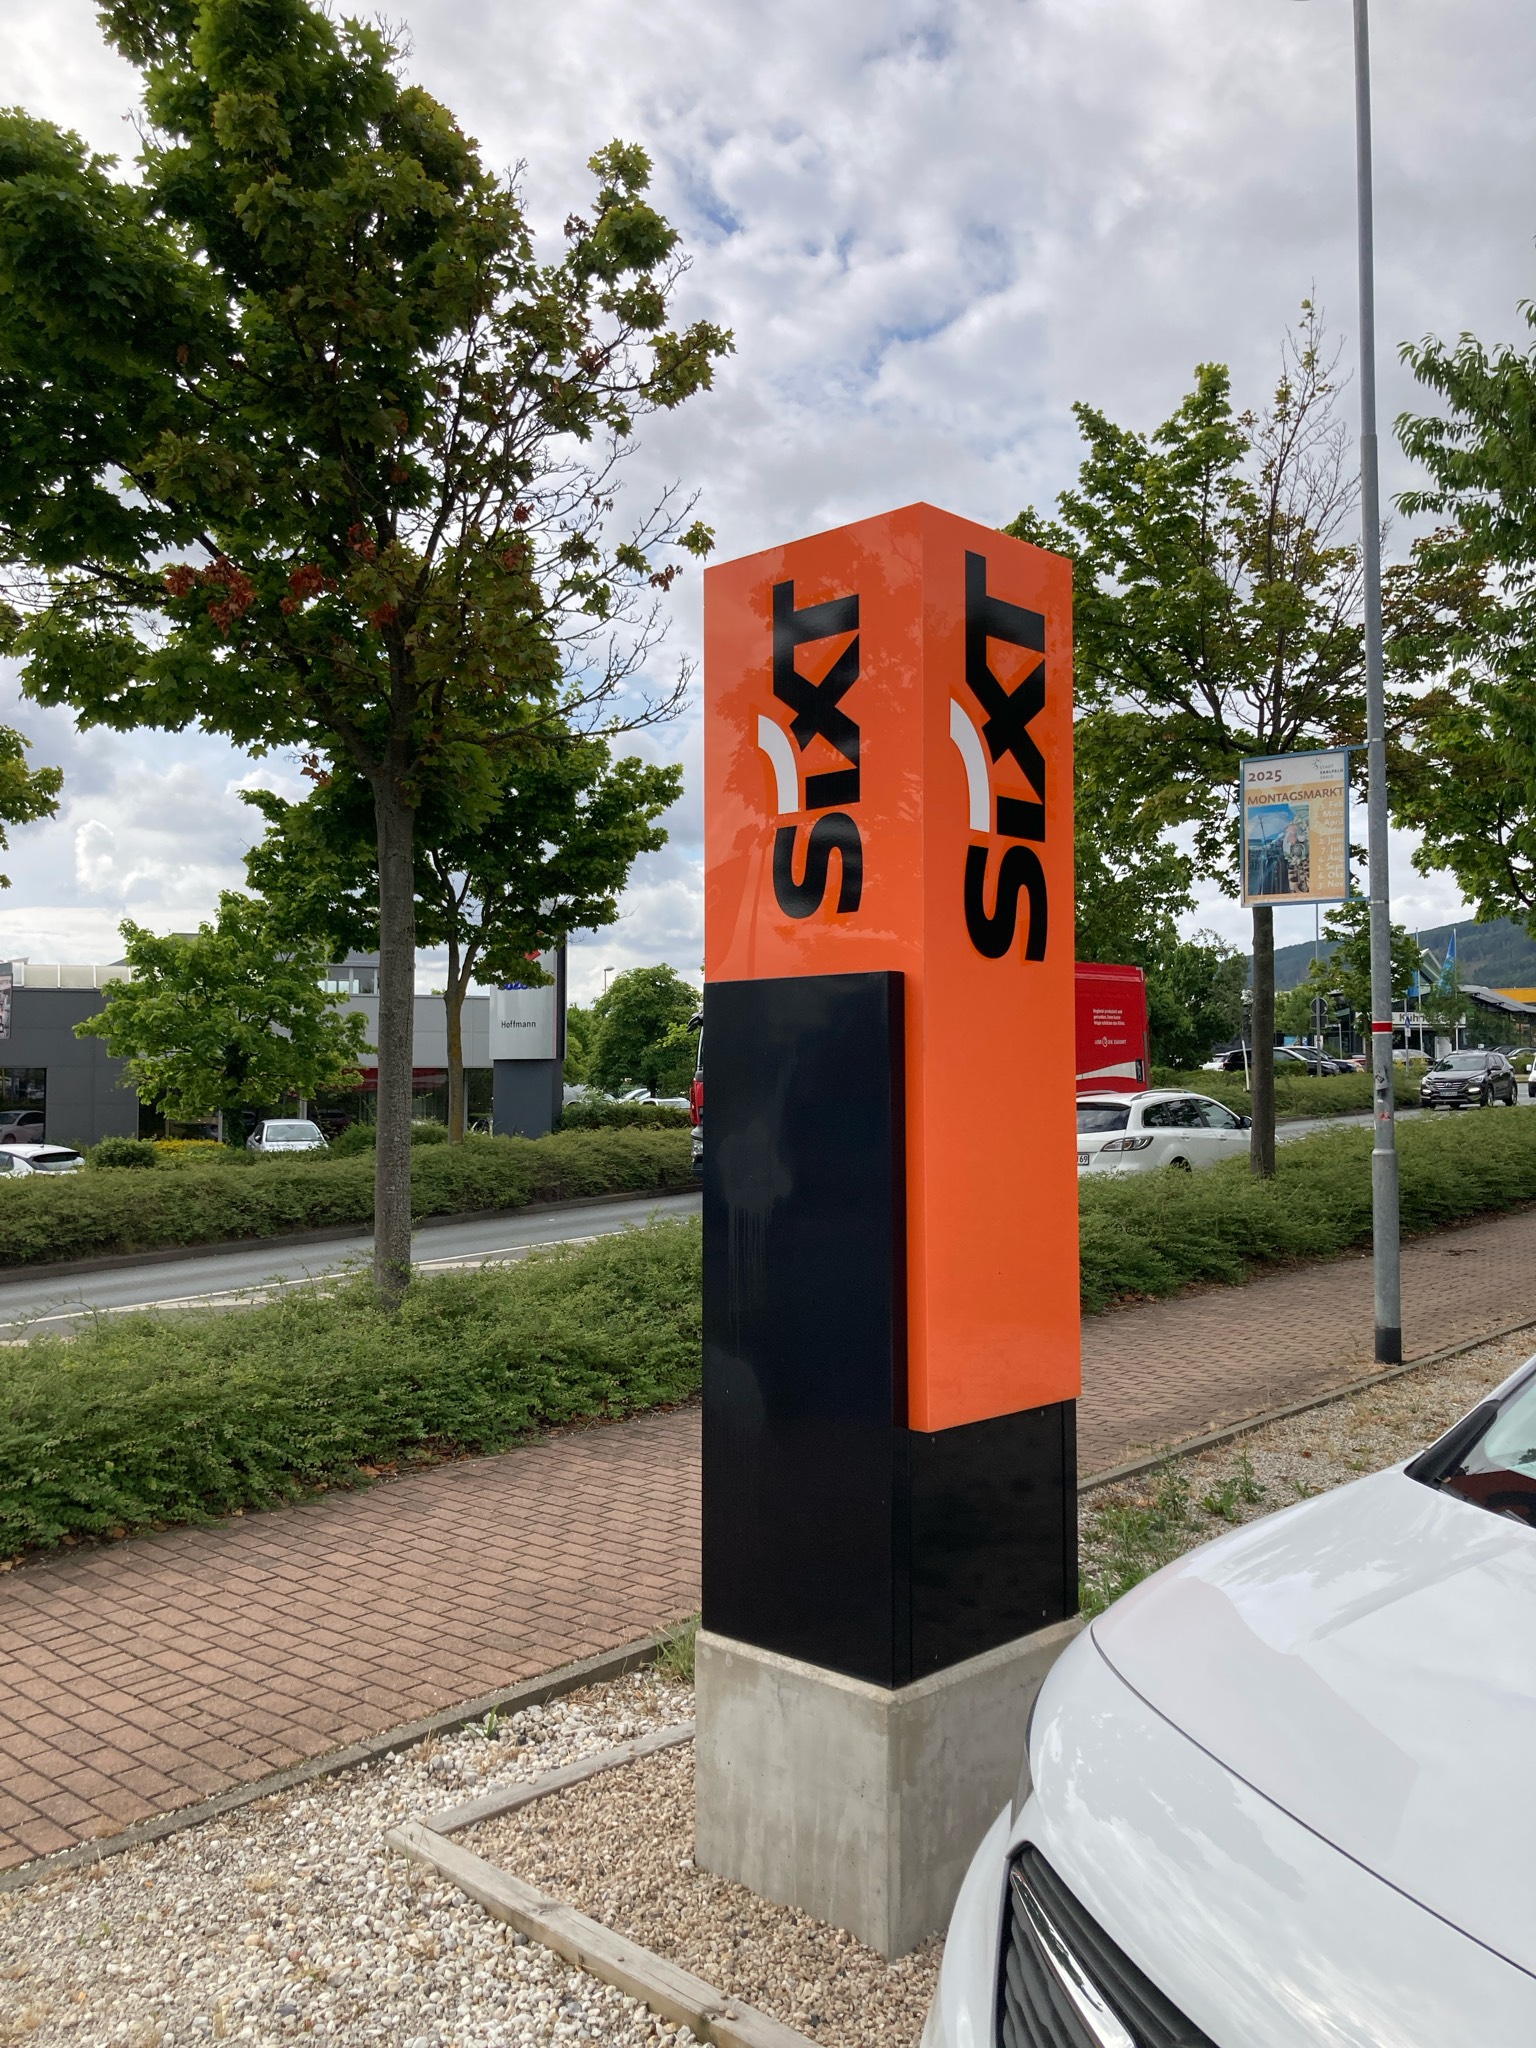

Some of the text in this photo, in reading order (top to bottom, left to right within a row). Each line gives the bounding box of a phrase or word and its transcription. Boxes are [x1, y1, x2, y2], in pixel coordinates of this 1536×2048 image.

[1248, 770, 1282, 782] 2025
[1247, 787, 1344, 805] MONTAGSMARKT
[501, 1020, 536, 1028] Hoffmann
